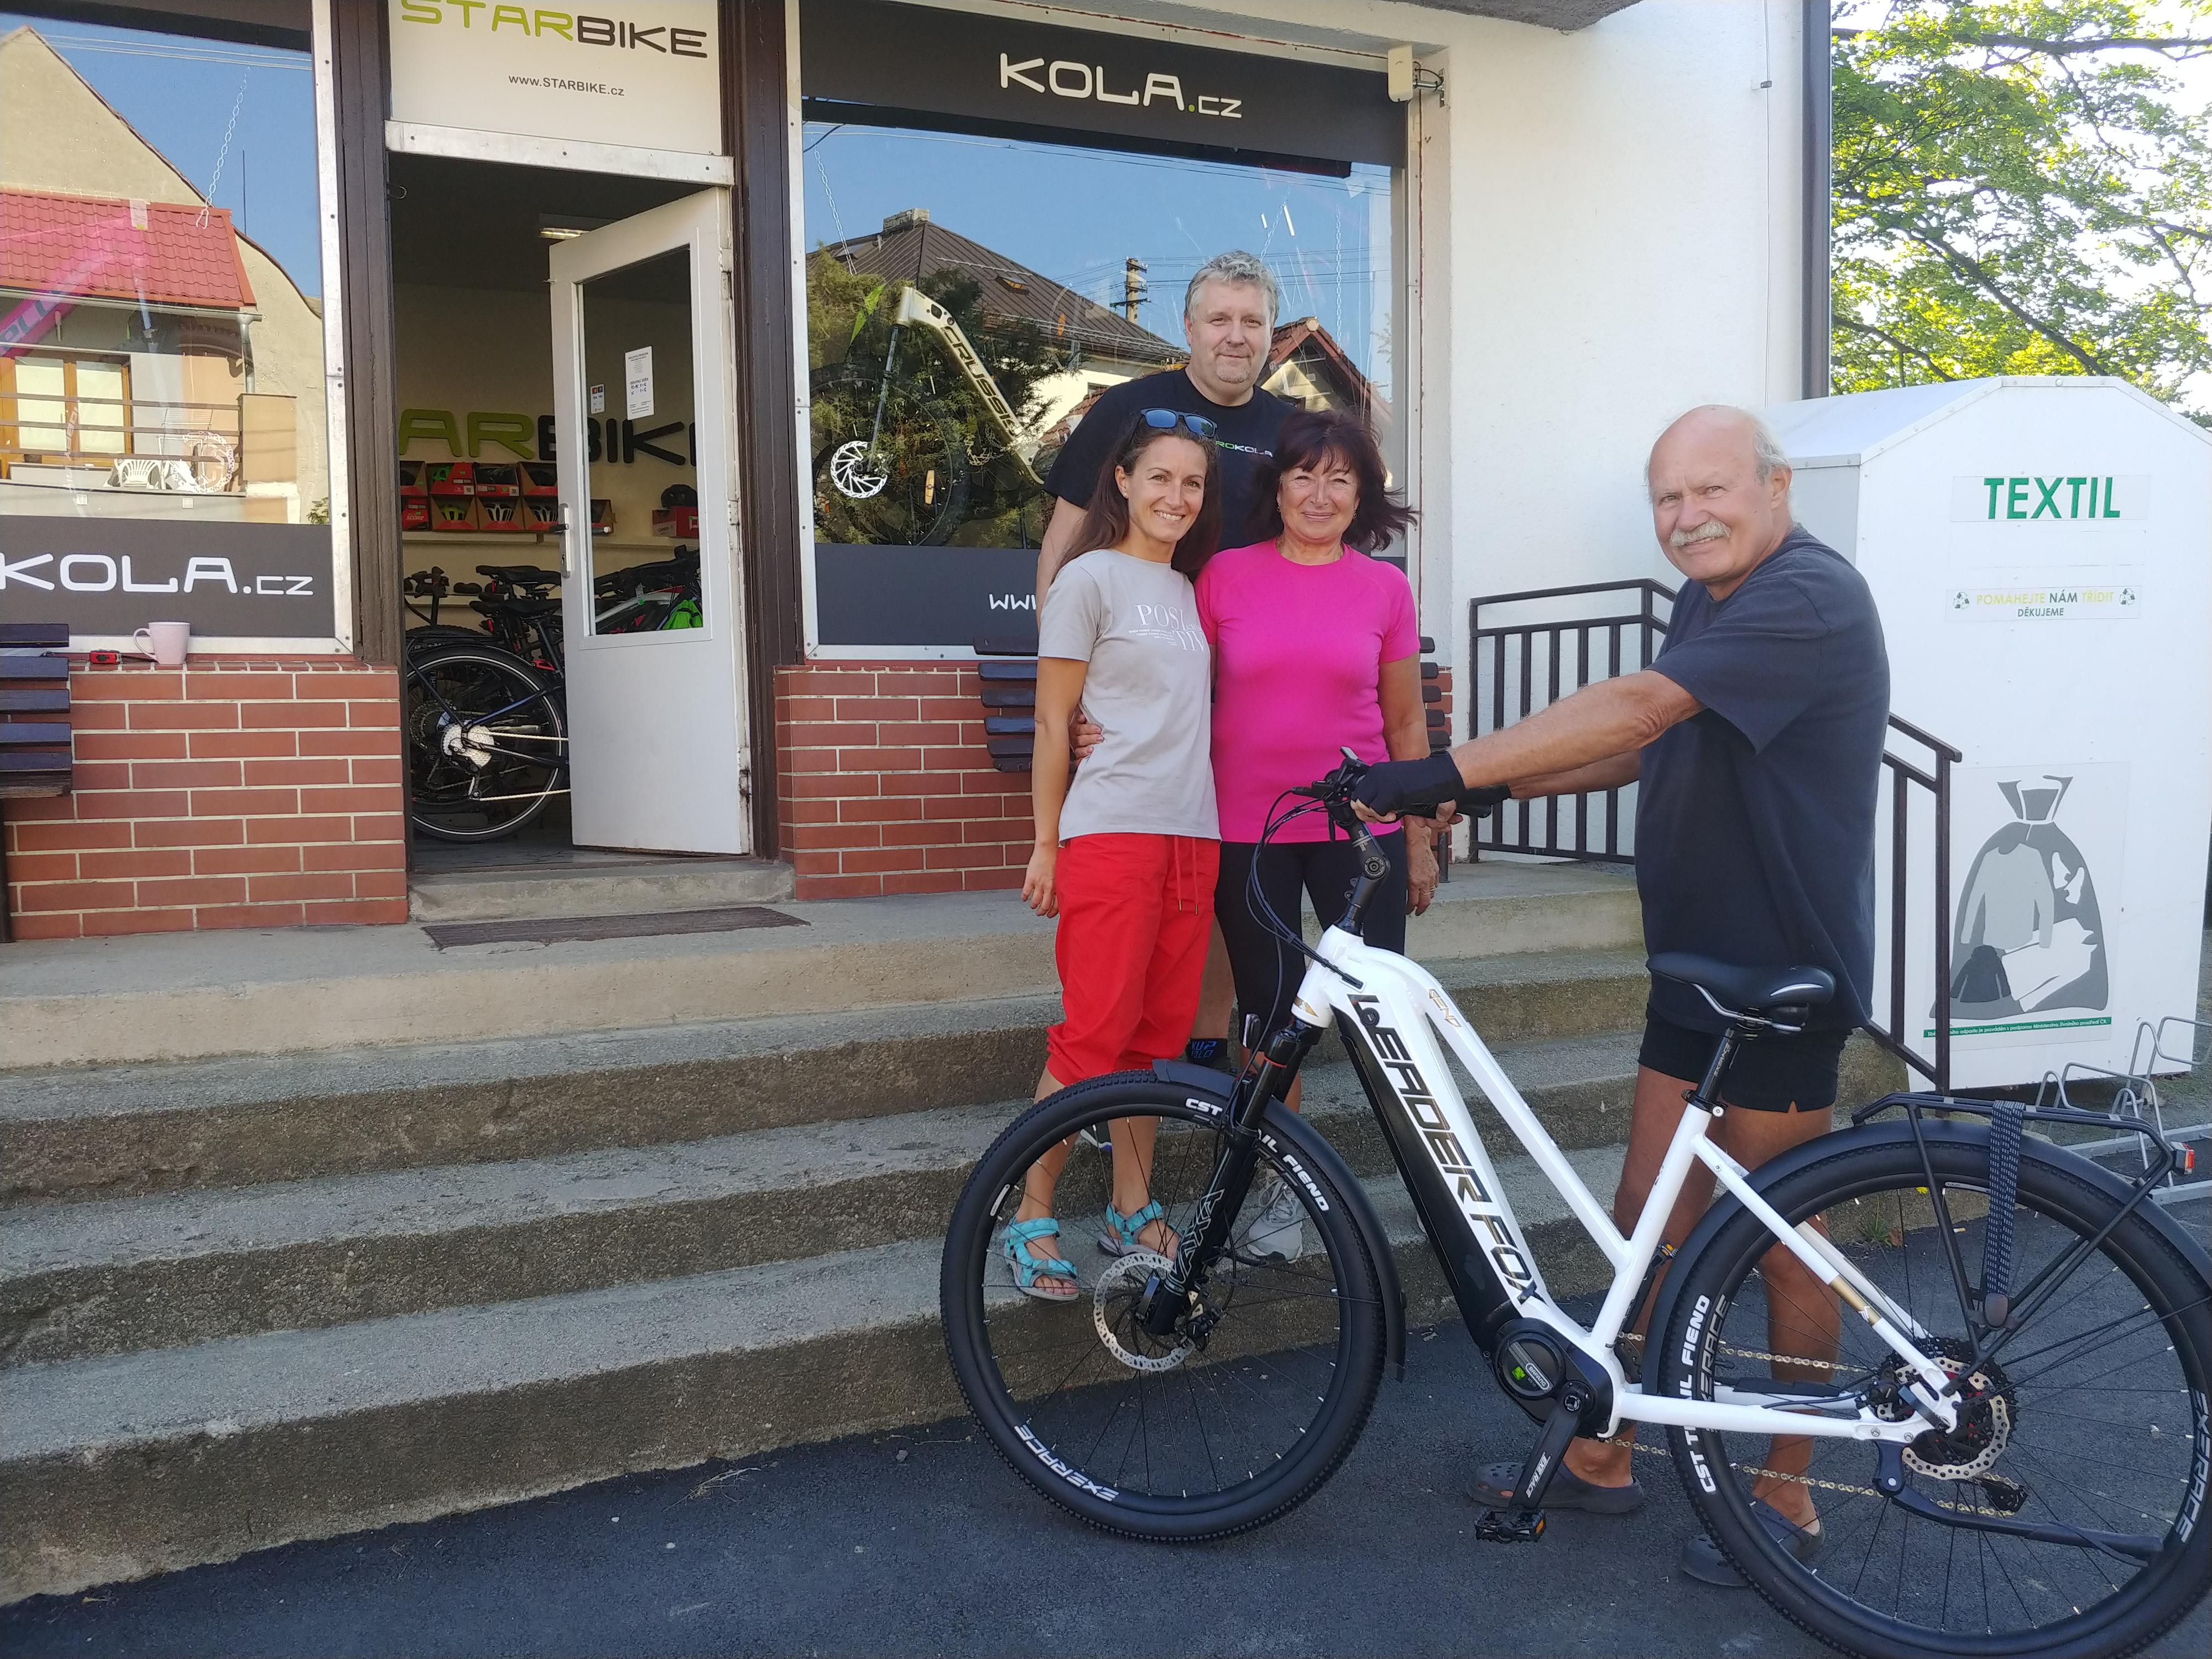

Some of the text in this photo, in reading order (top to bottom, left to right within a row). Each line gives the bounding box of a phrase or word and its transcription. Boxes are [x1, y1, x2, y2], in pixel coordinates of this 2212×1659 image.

[401, 0, 708, 58] STARBIKE
[508, 74, 625, 96] www.STARBIKE.cz
[1984, 476, 2120, 519] TEXTIL
[1976, 589, 2115, 605] POMÁHEJTE NÁM TŘÍDIT
[2017, 607, 2064, 617] DĚKUJEME
[1185, 1098, 1223, 1116] CST
[1282, 1154, 1330, 1212] FIEND
[1681, 1293, 1711, 1366] FIEND
[1689, 1451, 1717, 1493] CST
